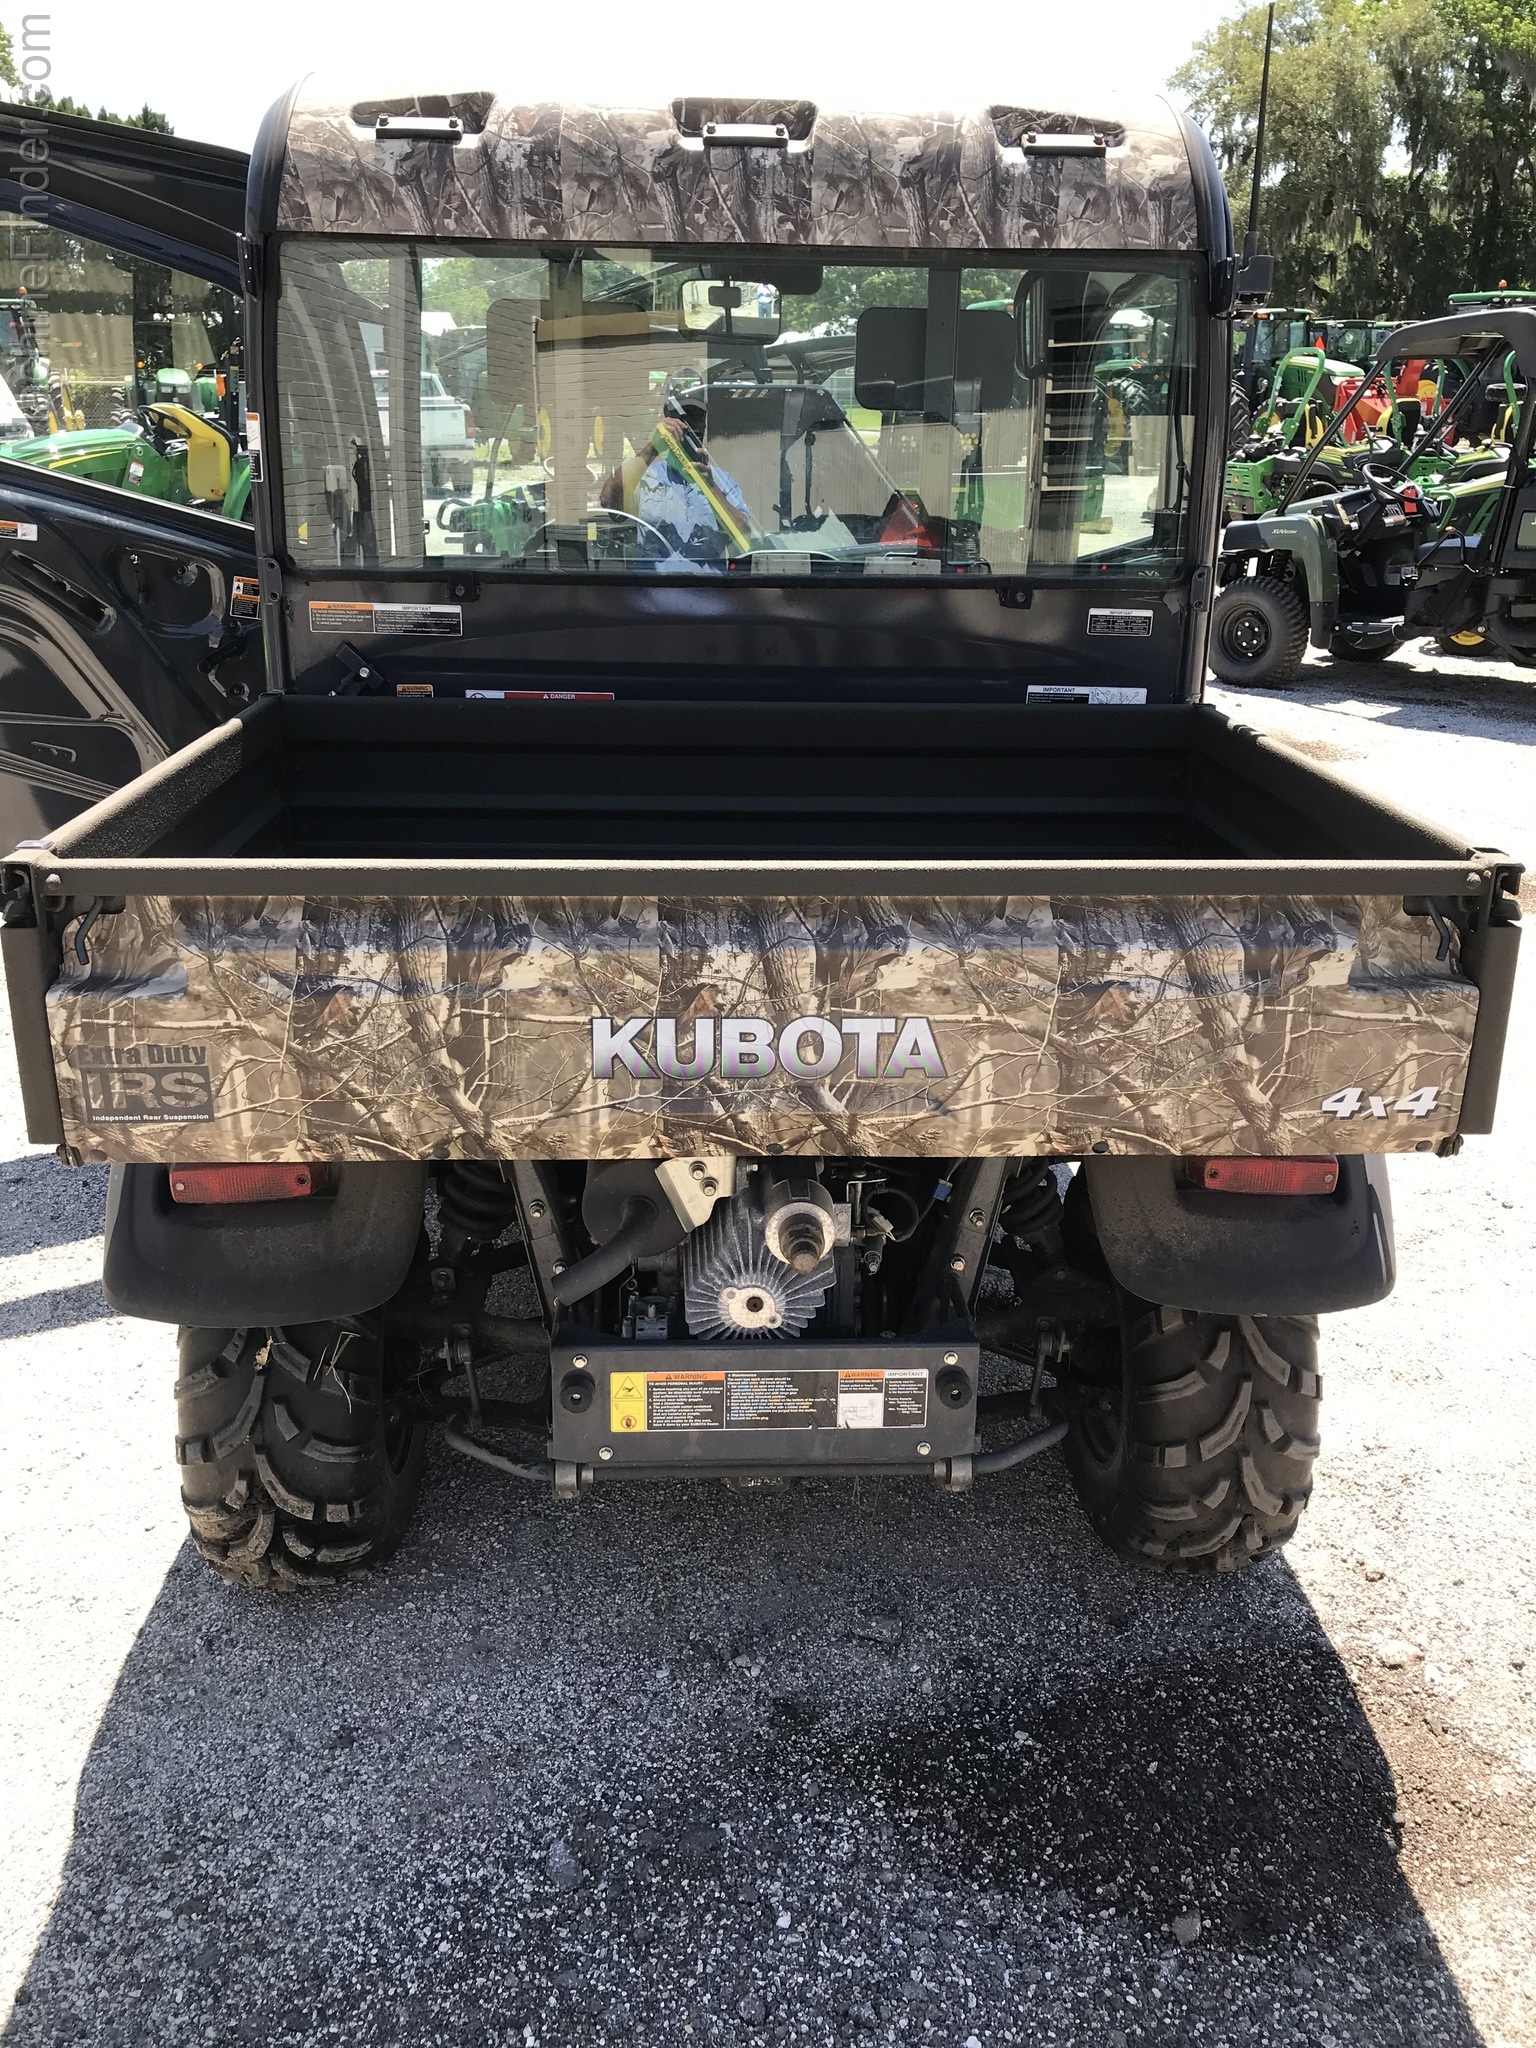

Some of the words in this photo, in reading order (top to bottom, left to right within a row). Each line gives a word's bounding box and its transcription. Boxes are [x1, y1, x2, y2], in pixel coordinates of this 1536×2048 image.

[77, 1045, 141, 1064] Extra
[147, 1045, 206, 1065] Duty
[592, 1016, 947, 1079] KUBOTA
[86, 1072, 208, 1109] IRS
[1322, 1086, 1441, 1120] 4x4
[163, 1113, 209, 1121] Suspension
